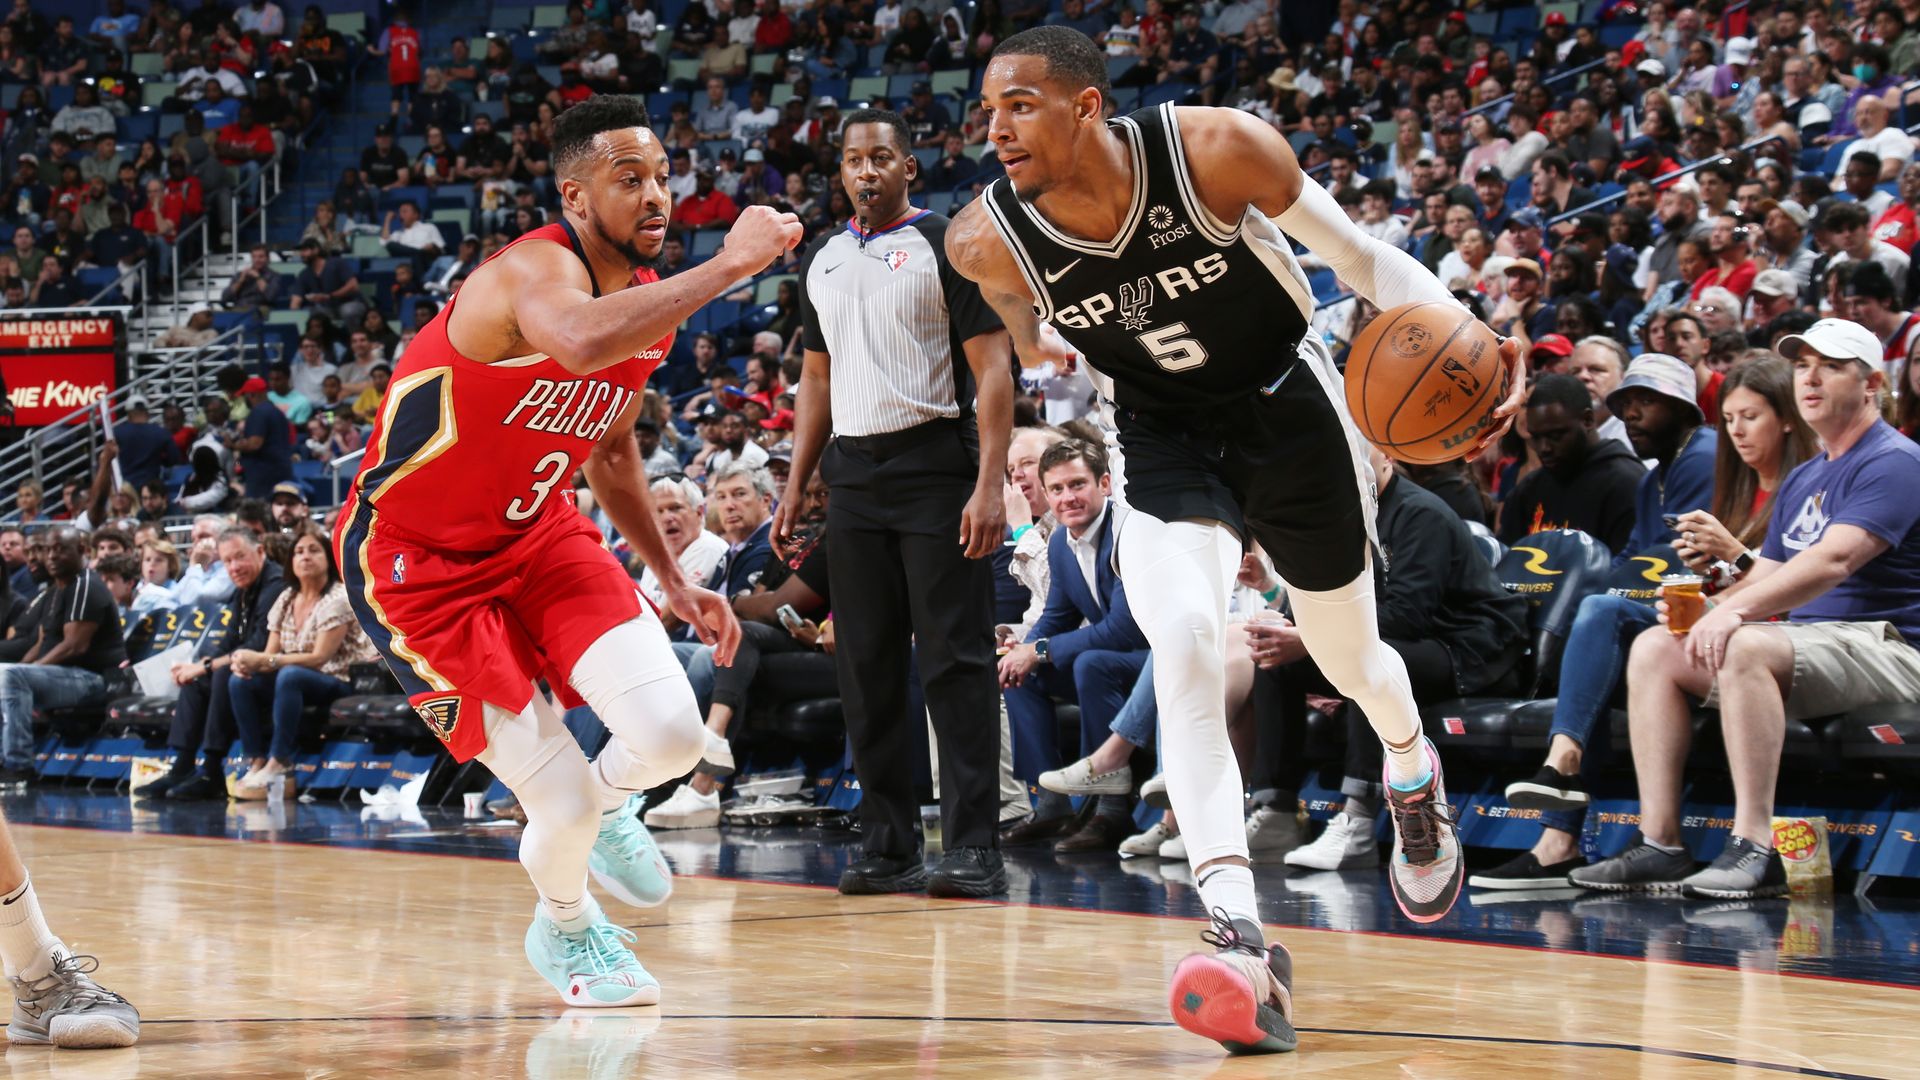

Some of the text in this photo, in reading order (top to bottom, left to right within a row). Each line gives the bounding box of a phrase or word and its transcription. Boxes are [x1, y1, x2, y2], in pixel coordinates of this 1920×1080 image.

[1148, 222, 1192, 249] Frost
[1055, 252, 1229, 331] SPURS
[0, 318, 110, 336] MERGENCY
[28, 333, 73, 348] EXIT
[1135, 321, 1210, 374] 5
[505, 450, 571, 521] 3
[1606, 587, 1656, 599] BETRIVE
[1777, 825, 1807, 842] POP
[1777, 834, 1817, 854] CORN
